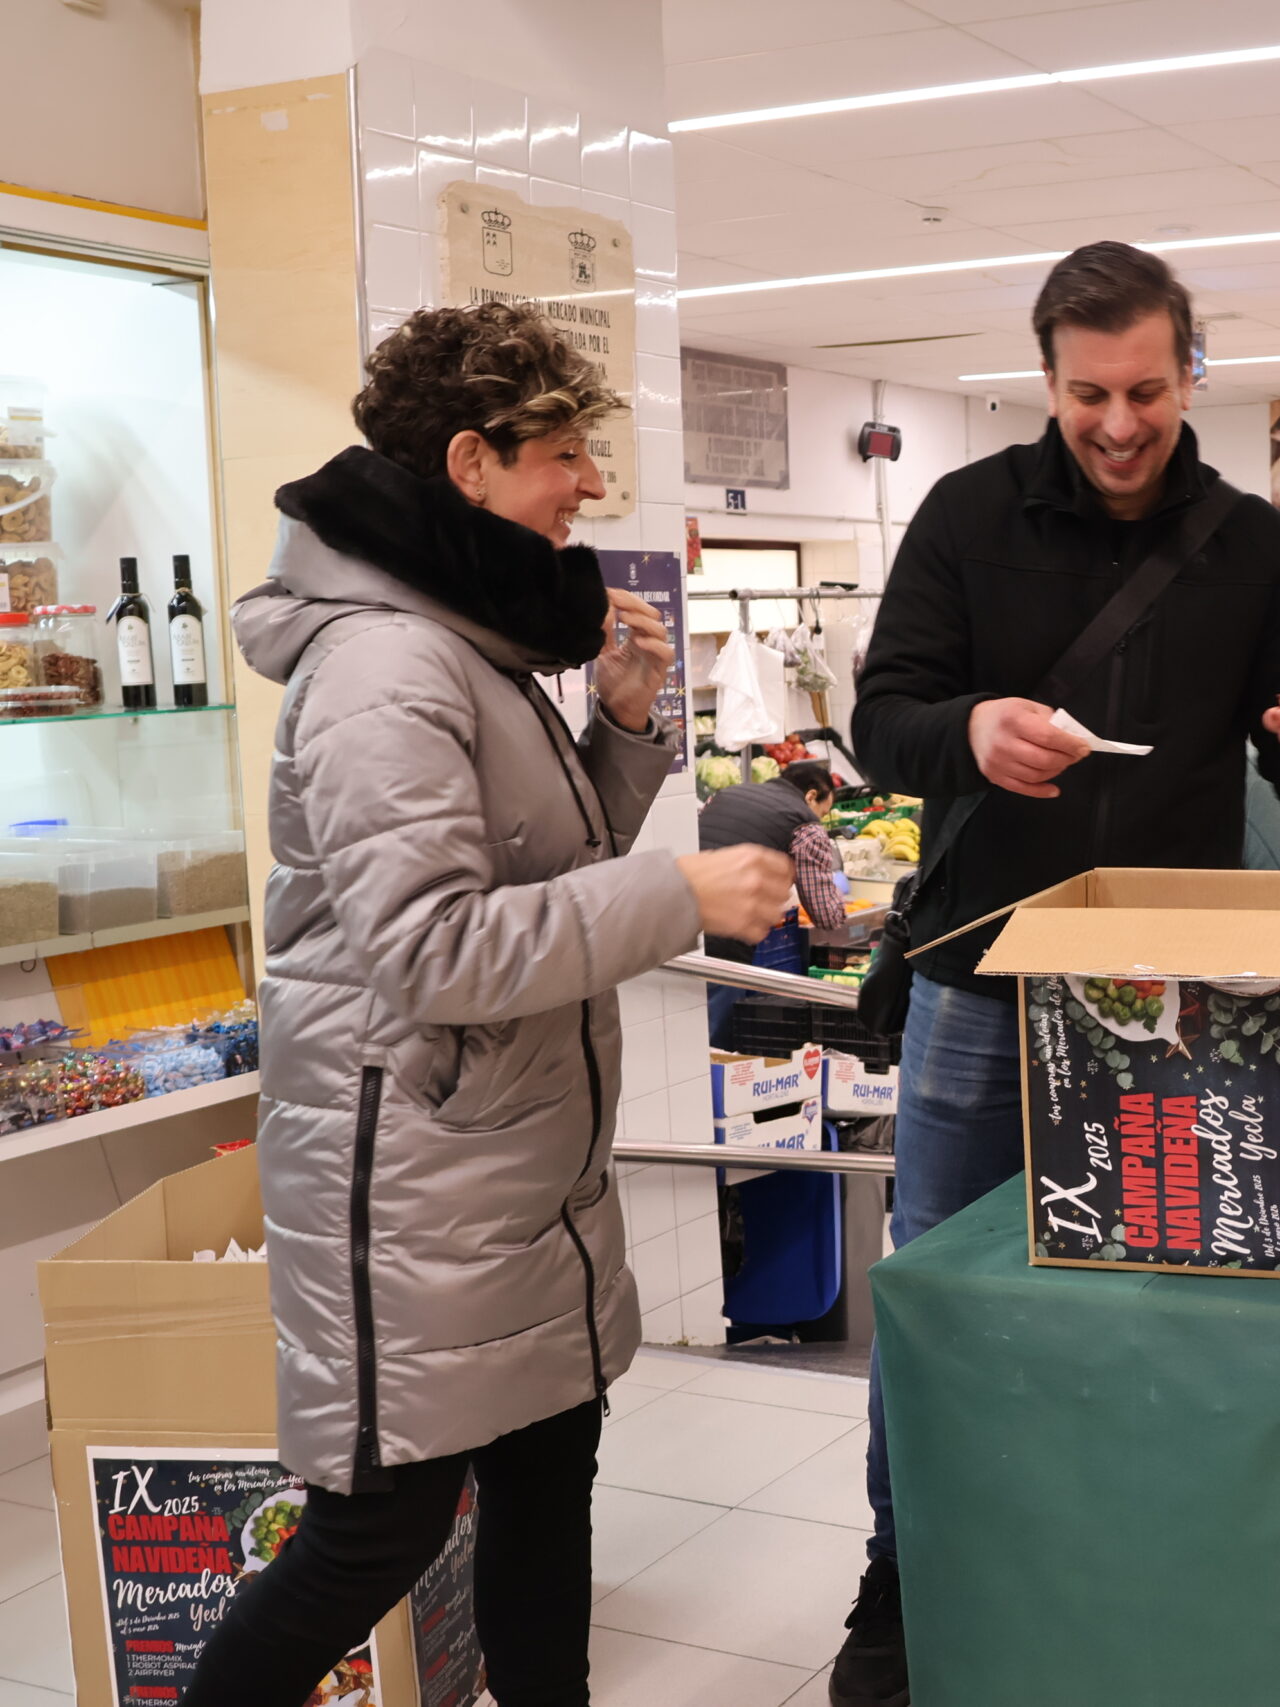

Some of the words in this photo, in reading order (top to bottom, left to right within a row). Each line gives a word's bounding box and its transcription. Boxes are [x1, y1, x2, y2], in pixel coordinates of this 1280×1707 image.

[470, 286, 478, 304] LA
[548, 301, 577, 325] MERCADO
[579, 306, 611, 328] MUNICIPAL
[588, 338, 601, 352] POR
[602, 339, 610, 354] EL
[1052, 1008, 1069, 1058] Mercados
[753, 1074, 799, 1096] RUI-MAR
[853, 1084, 893, 1099] RUI-MAR
[1228, 1095, 1277, 1161] Yecla
[1040, 1172, 1102, 1243] IX
[1083, 1122, 1112, 1171] 2025
[1114, 1092, 1160, 1248] CAMPAÑA
[1156, 1096, 1202, 1250] NAVIDEÑA
[1191, 1088, 1254, 1256] Mercados
[1253, 1174, 1263, 1191] 2025
[1262, 1227, 1271, 1236] de
[109, 1465, 162, 1514] IX
[164, 1496, 200, 1516] 2025
[238, 1477, 275, 1490] Mercados
[108, 1511, 230, 1542] CAMPAÑA
[112, 1542, 232, 1574] NAVIDEÑA
[113, 1568, 239, 1612] Mercados
[190, 1597, 232, 1630] Yecl
[175, 1640, 207, 1653] Mercad
